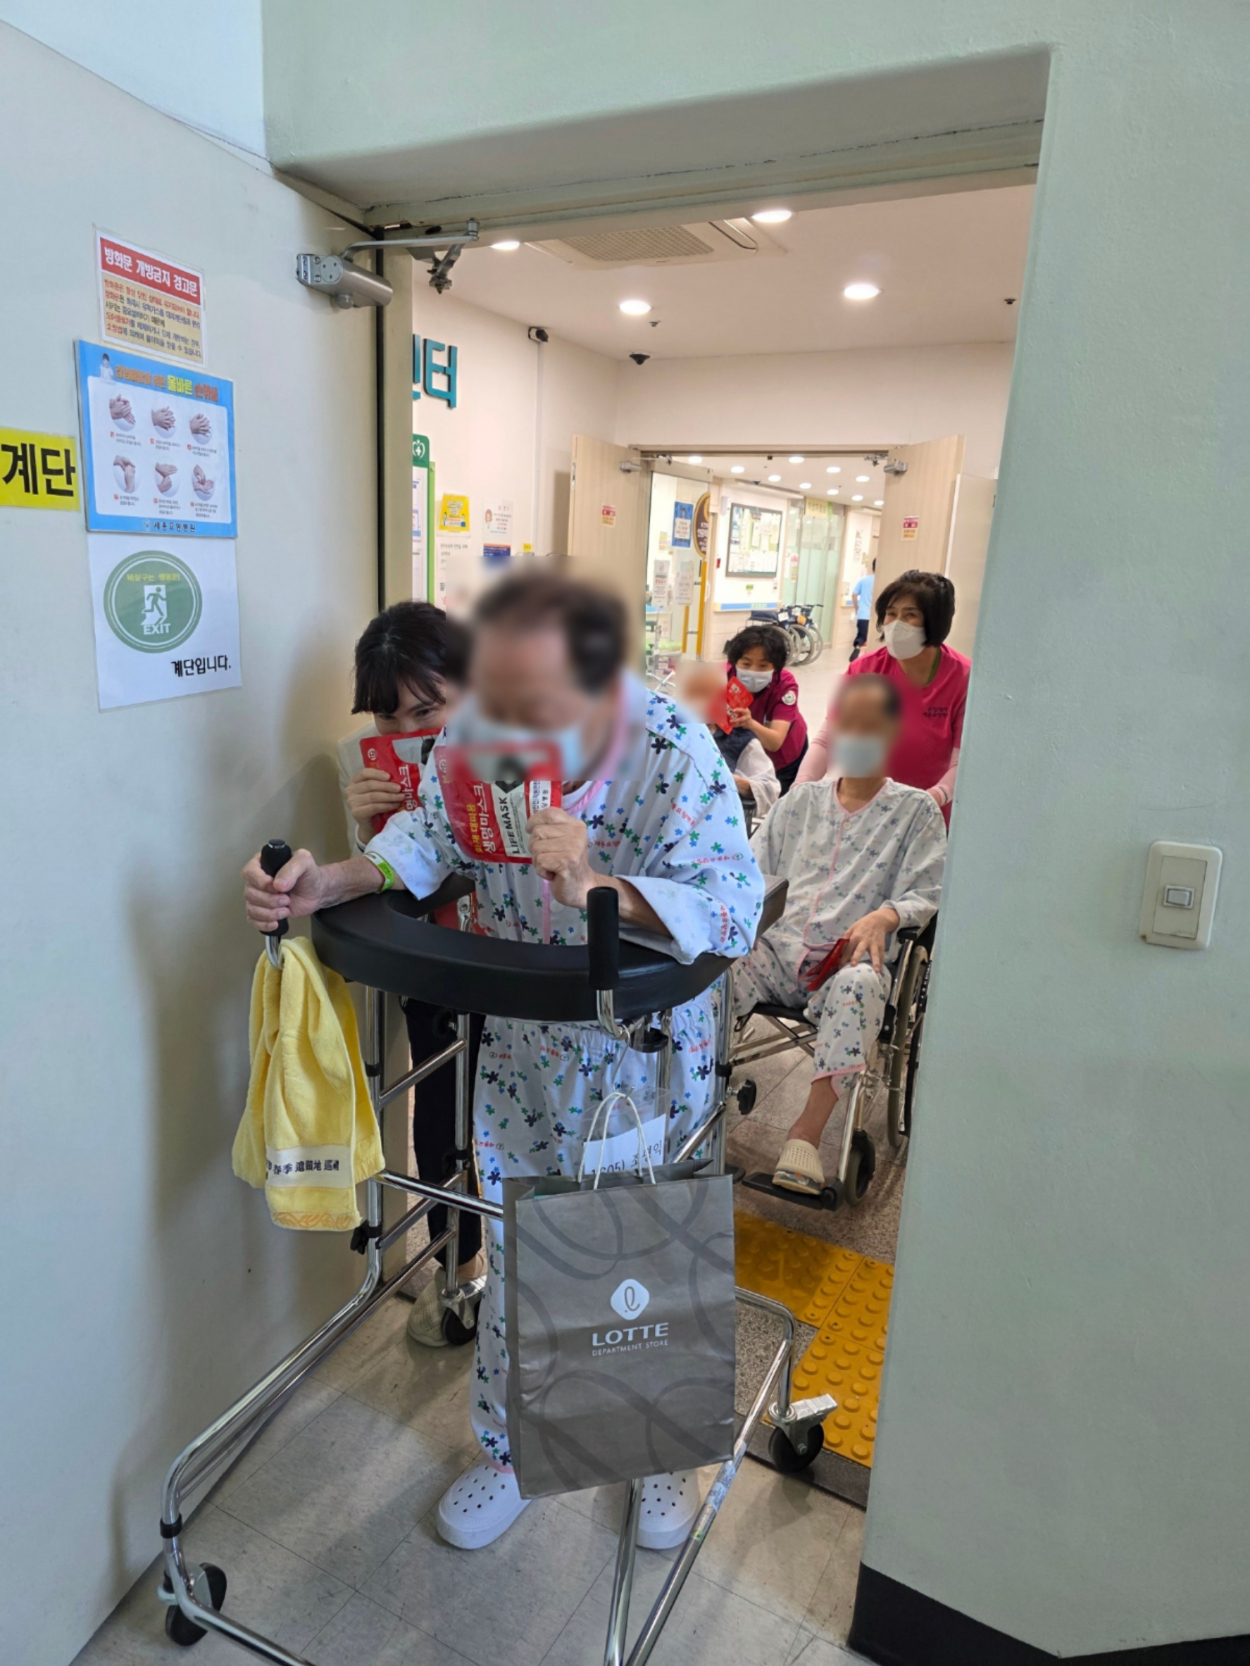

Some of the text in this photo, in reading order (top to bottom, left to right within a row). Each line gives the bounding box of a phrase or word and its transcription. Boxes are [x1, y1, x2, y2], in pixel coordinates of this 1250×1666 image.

[104, 247, 198, 297] 방화문 개방금지 경고문
[168, 374, 193, 396] 올바른
[1, 443, 76, 497] 계단
[143, 623, 171, 635] EXIT
[171, 654, 232, 678] 계단입니다.
[466, 803, 479, 832] 대피용
[473, 783, 496, 854] 생명마스크
[498, 797, 513, 829] MASK
[506, 830, 521, 854] LIFE
[592, 1322, 669, 1347] LOTTE
[592, 1339, 669, 1357] DEPARTMENT STORE
